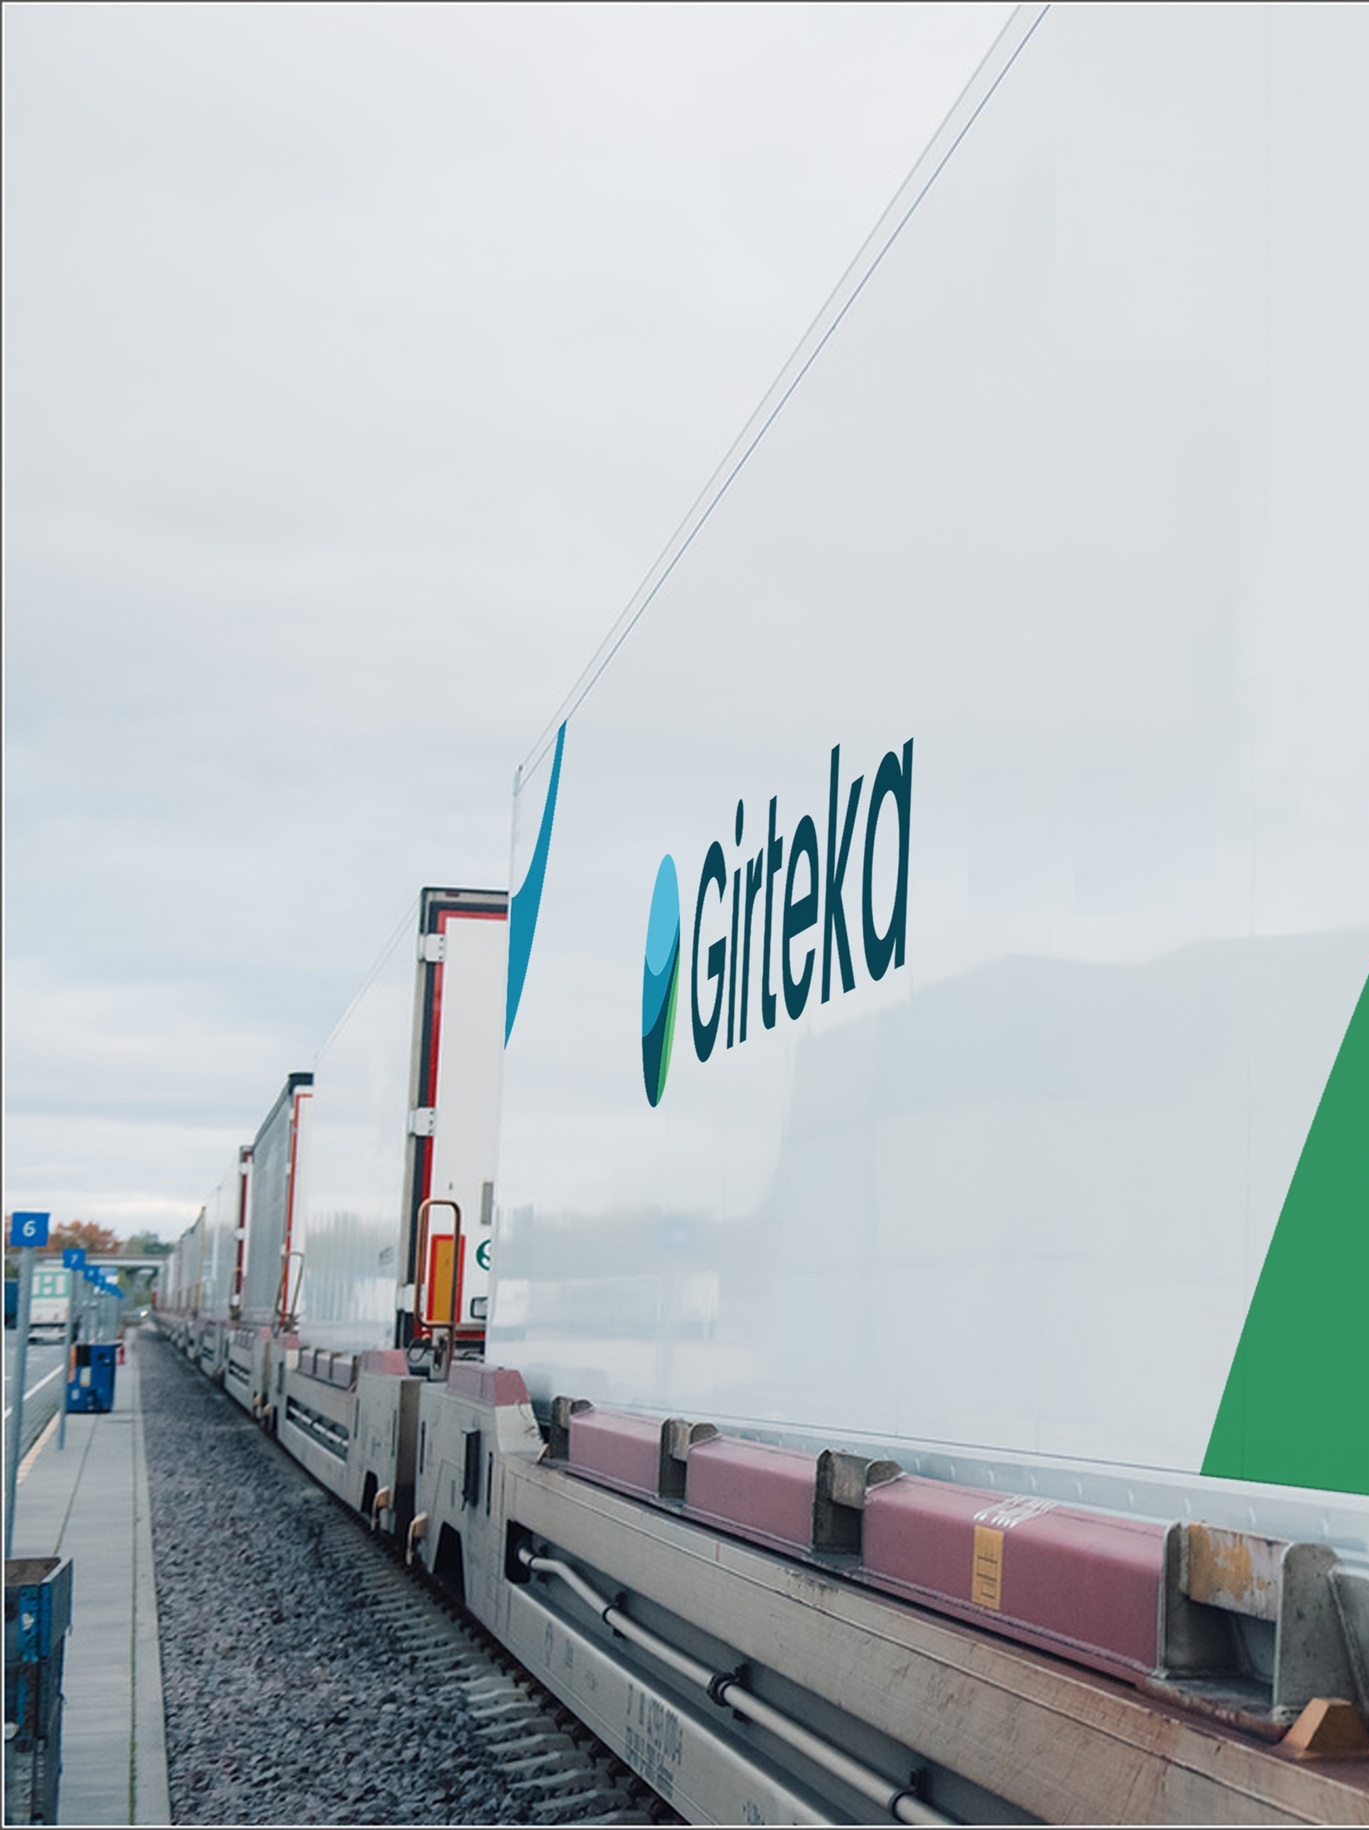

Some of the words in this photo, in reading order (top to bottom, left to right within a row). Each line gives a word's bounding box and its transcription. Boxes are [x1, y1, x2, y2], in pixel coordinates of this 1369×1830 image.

[691, 737, 914, 1062] Girteka
[22, 1220, 36, 1237] 6
[71, 1254, 78, 1265] 7
